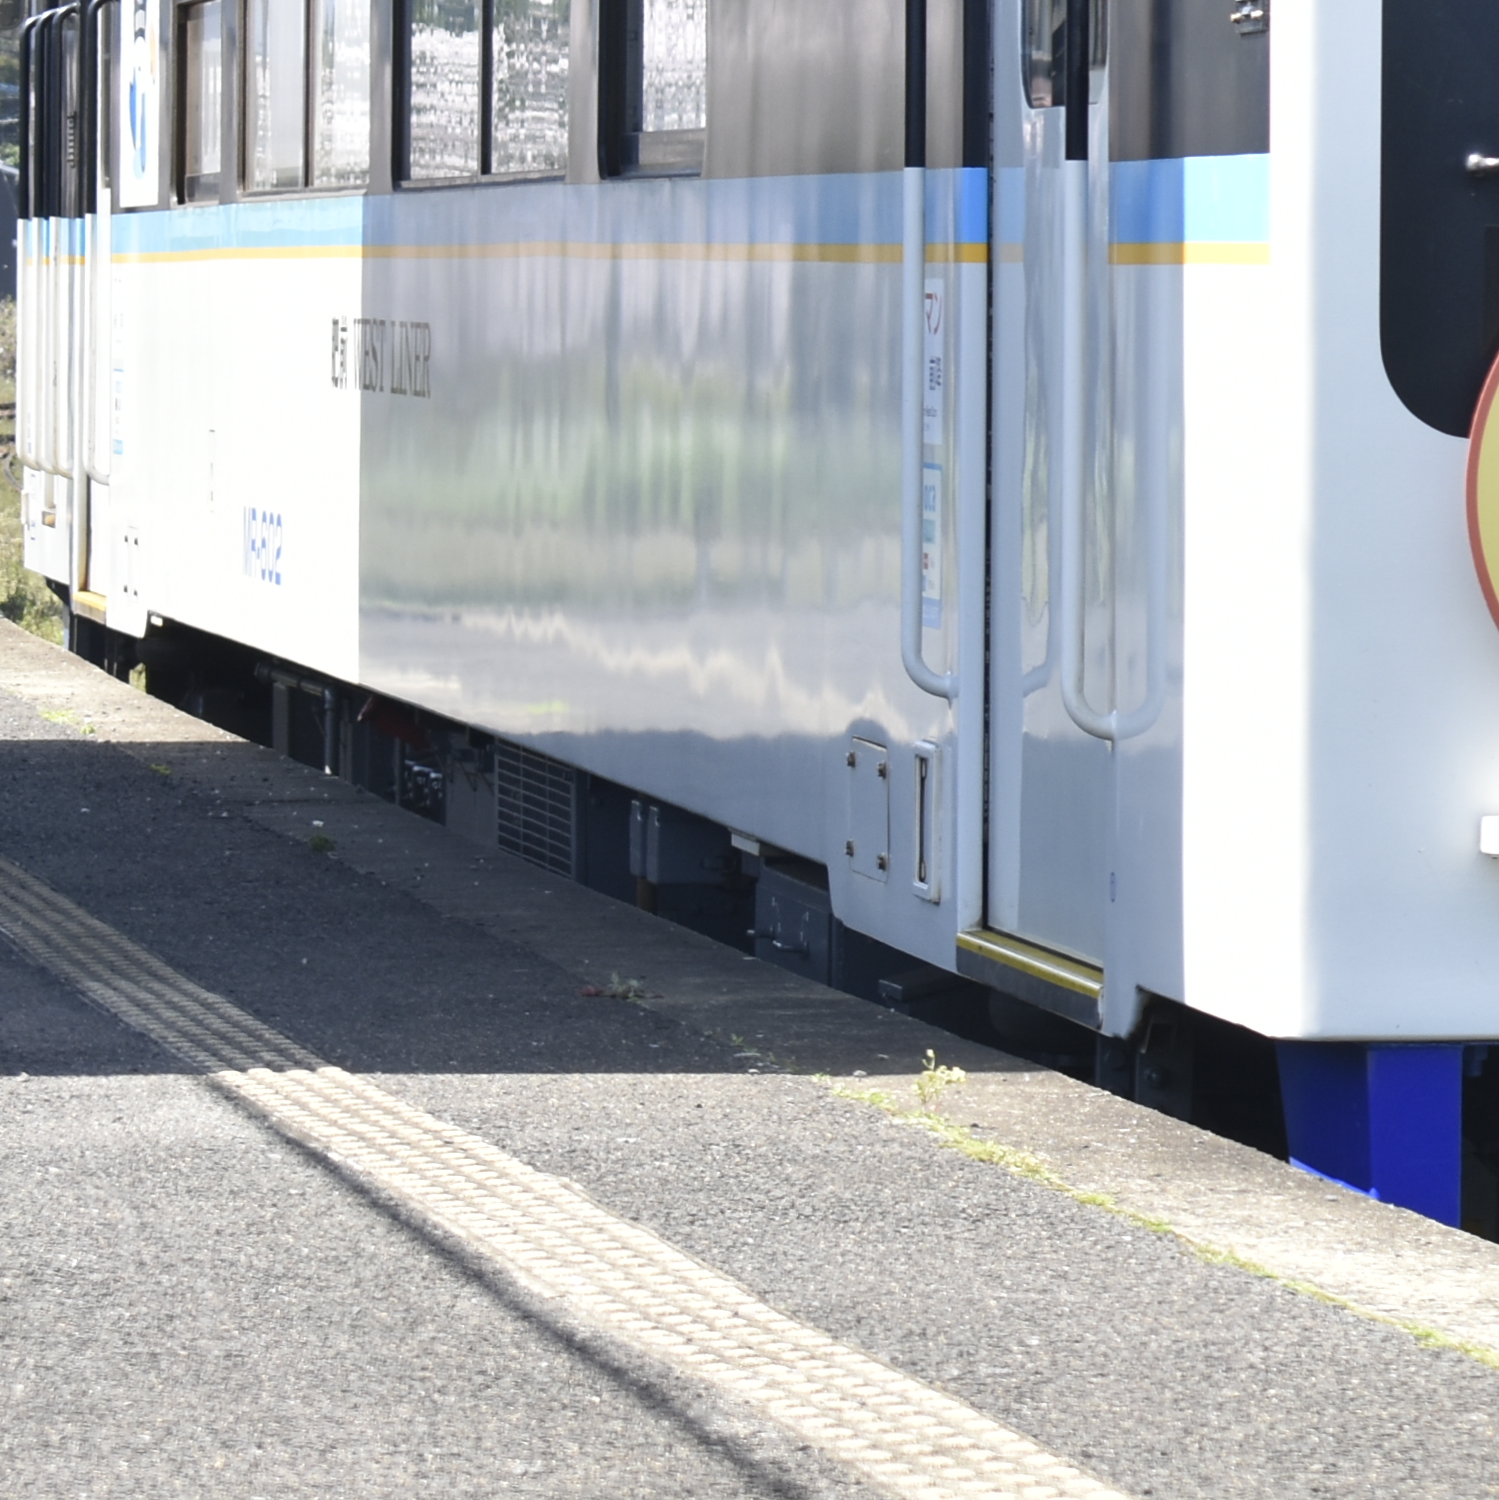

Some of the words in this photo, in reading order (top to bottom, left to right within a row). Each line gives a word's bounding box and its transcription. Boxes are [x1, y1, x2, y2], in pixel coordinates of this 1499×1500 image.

[353, 317, 386, 392] WEST
[390, 319, 431, 398] LINER
[242, 505, 284, 586] MR-602
